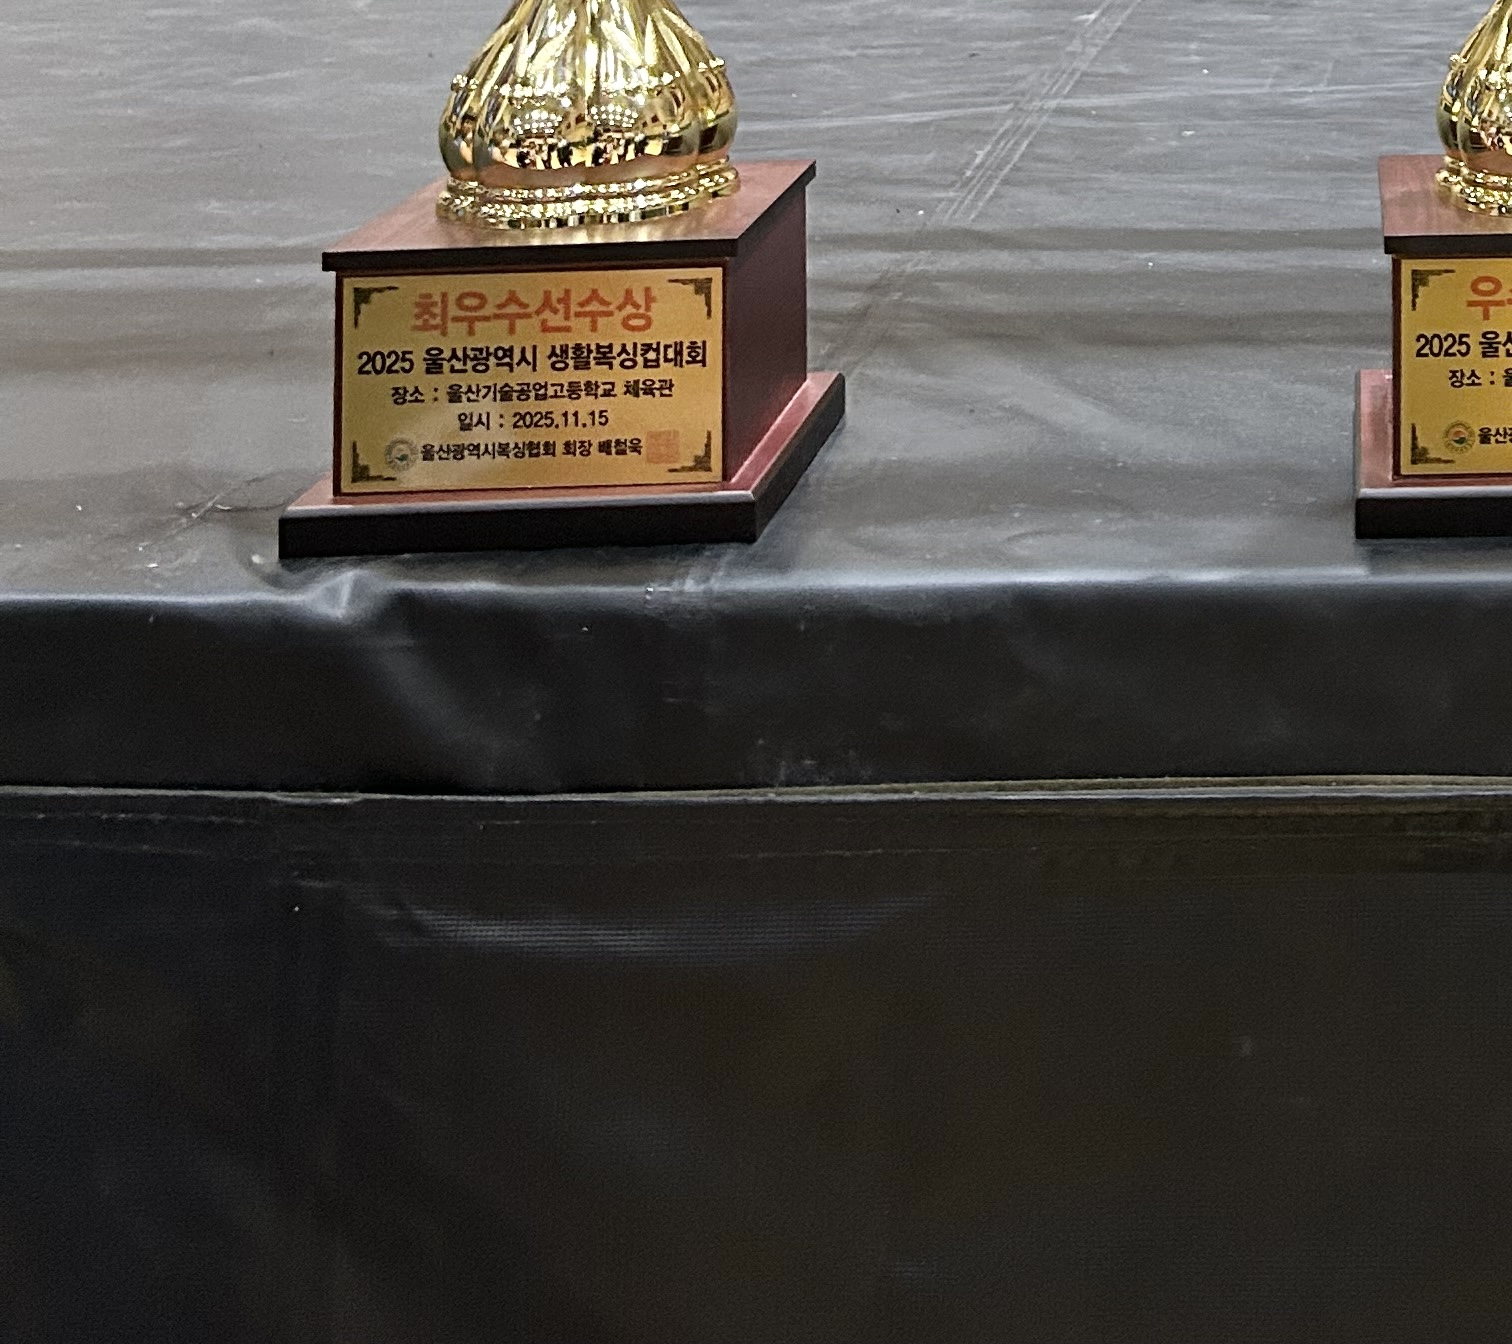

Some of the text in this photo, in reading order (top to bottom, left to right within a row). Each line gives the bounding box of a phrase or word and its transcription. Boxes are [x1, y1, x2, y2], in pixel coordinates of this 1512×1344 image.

[411, 286, 657, 336] 최우수선수상
[1416, 333, 1471, 357] 2025
[357, 340, 706, 375] 2025 울산광역시 생활복싱컵대회
[1449, 369, 1482, 388] 장소
[391, 386, 425, 405] 장소
[446, 381, 617, 403] 울산기술공업고등학교
[624, 379, 674, 398] 체육관
[458, 412, 490, 432] 일시
[512, 410, 608, 429] 2025.11.15
[562, 440, 593, 457] 회장
